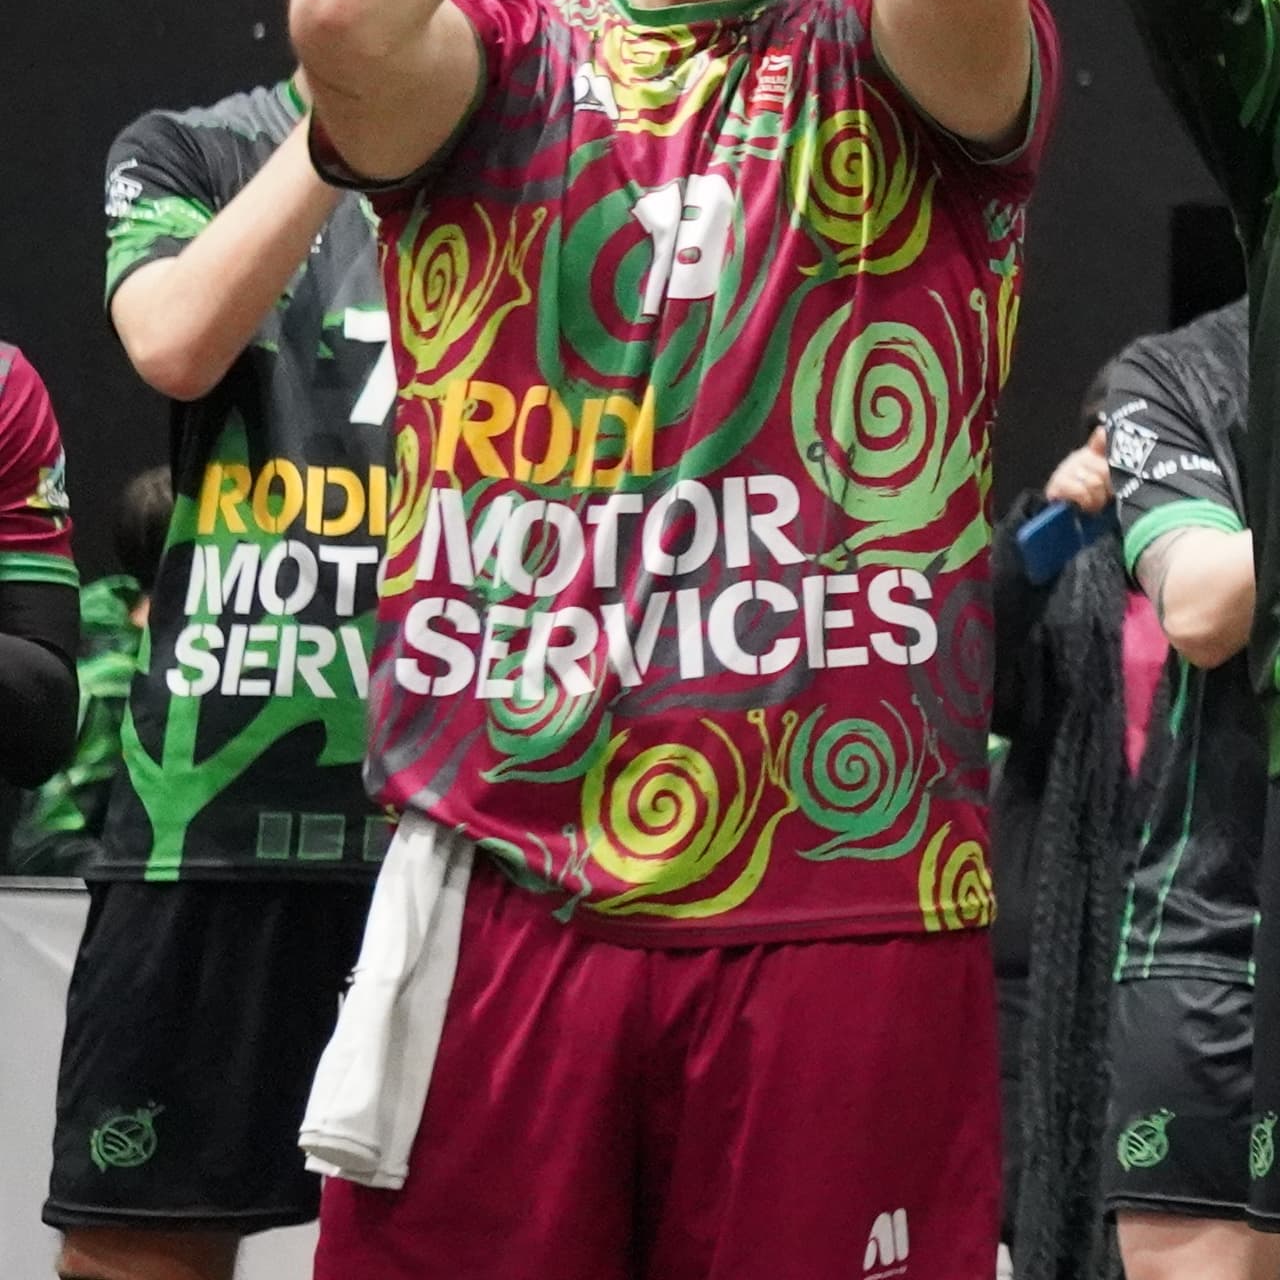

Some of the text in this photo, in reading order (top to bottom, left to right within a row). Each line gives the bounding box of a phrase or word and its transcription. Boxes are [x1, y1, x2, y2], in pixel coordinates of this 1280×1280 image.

[435, 379, 655, 488] RODI
[197, 458, 387, 536] RODI
[415, 475, 808, 597] MOTOR
[184, 539, 385, 617] MOT
[395, 569, 939, 700] SERVICES
